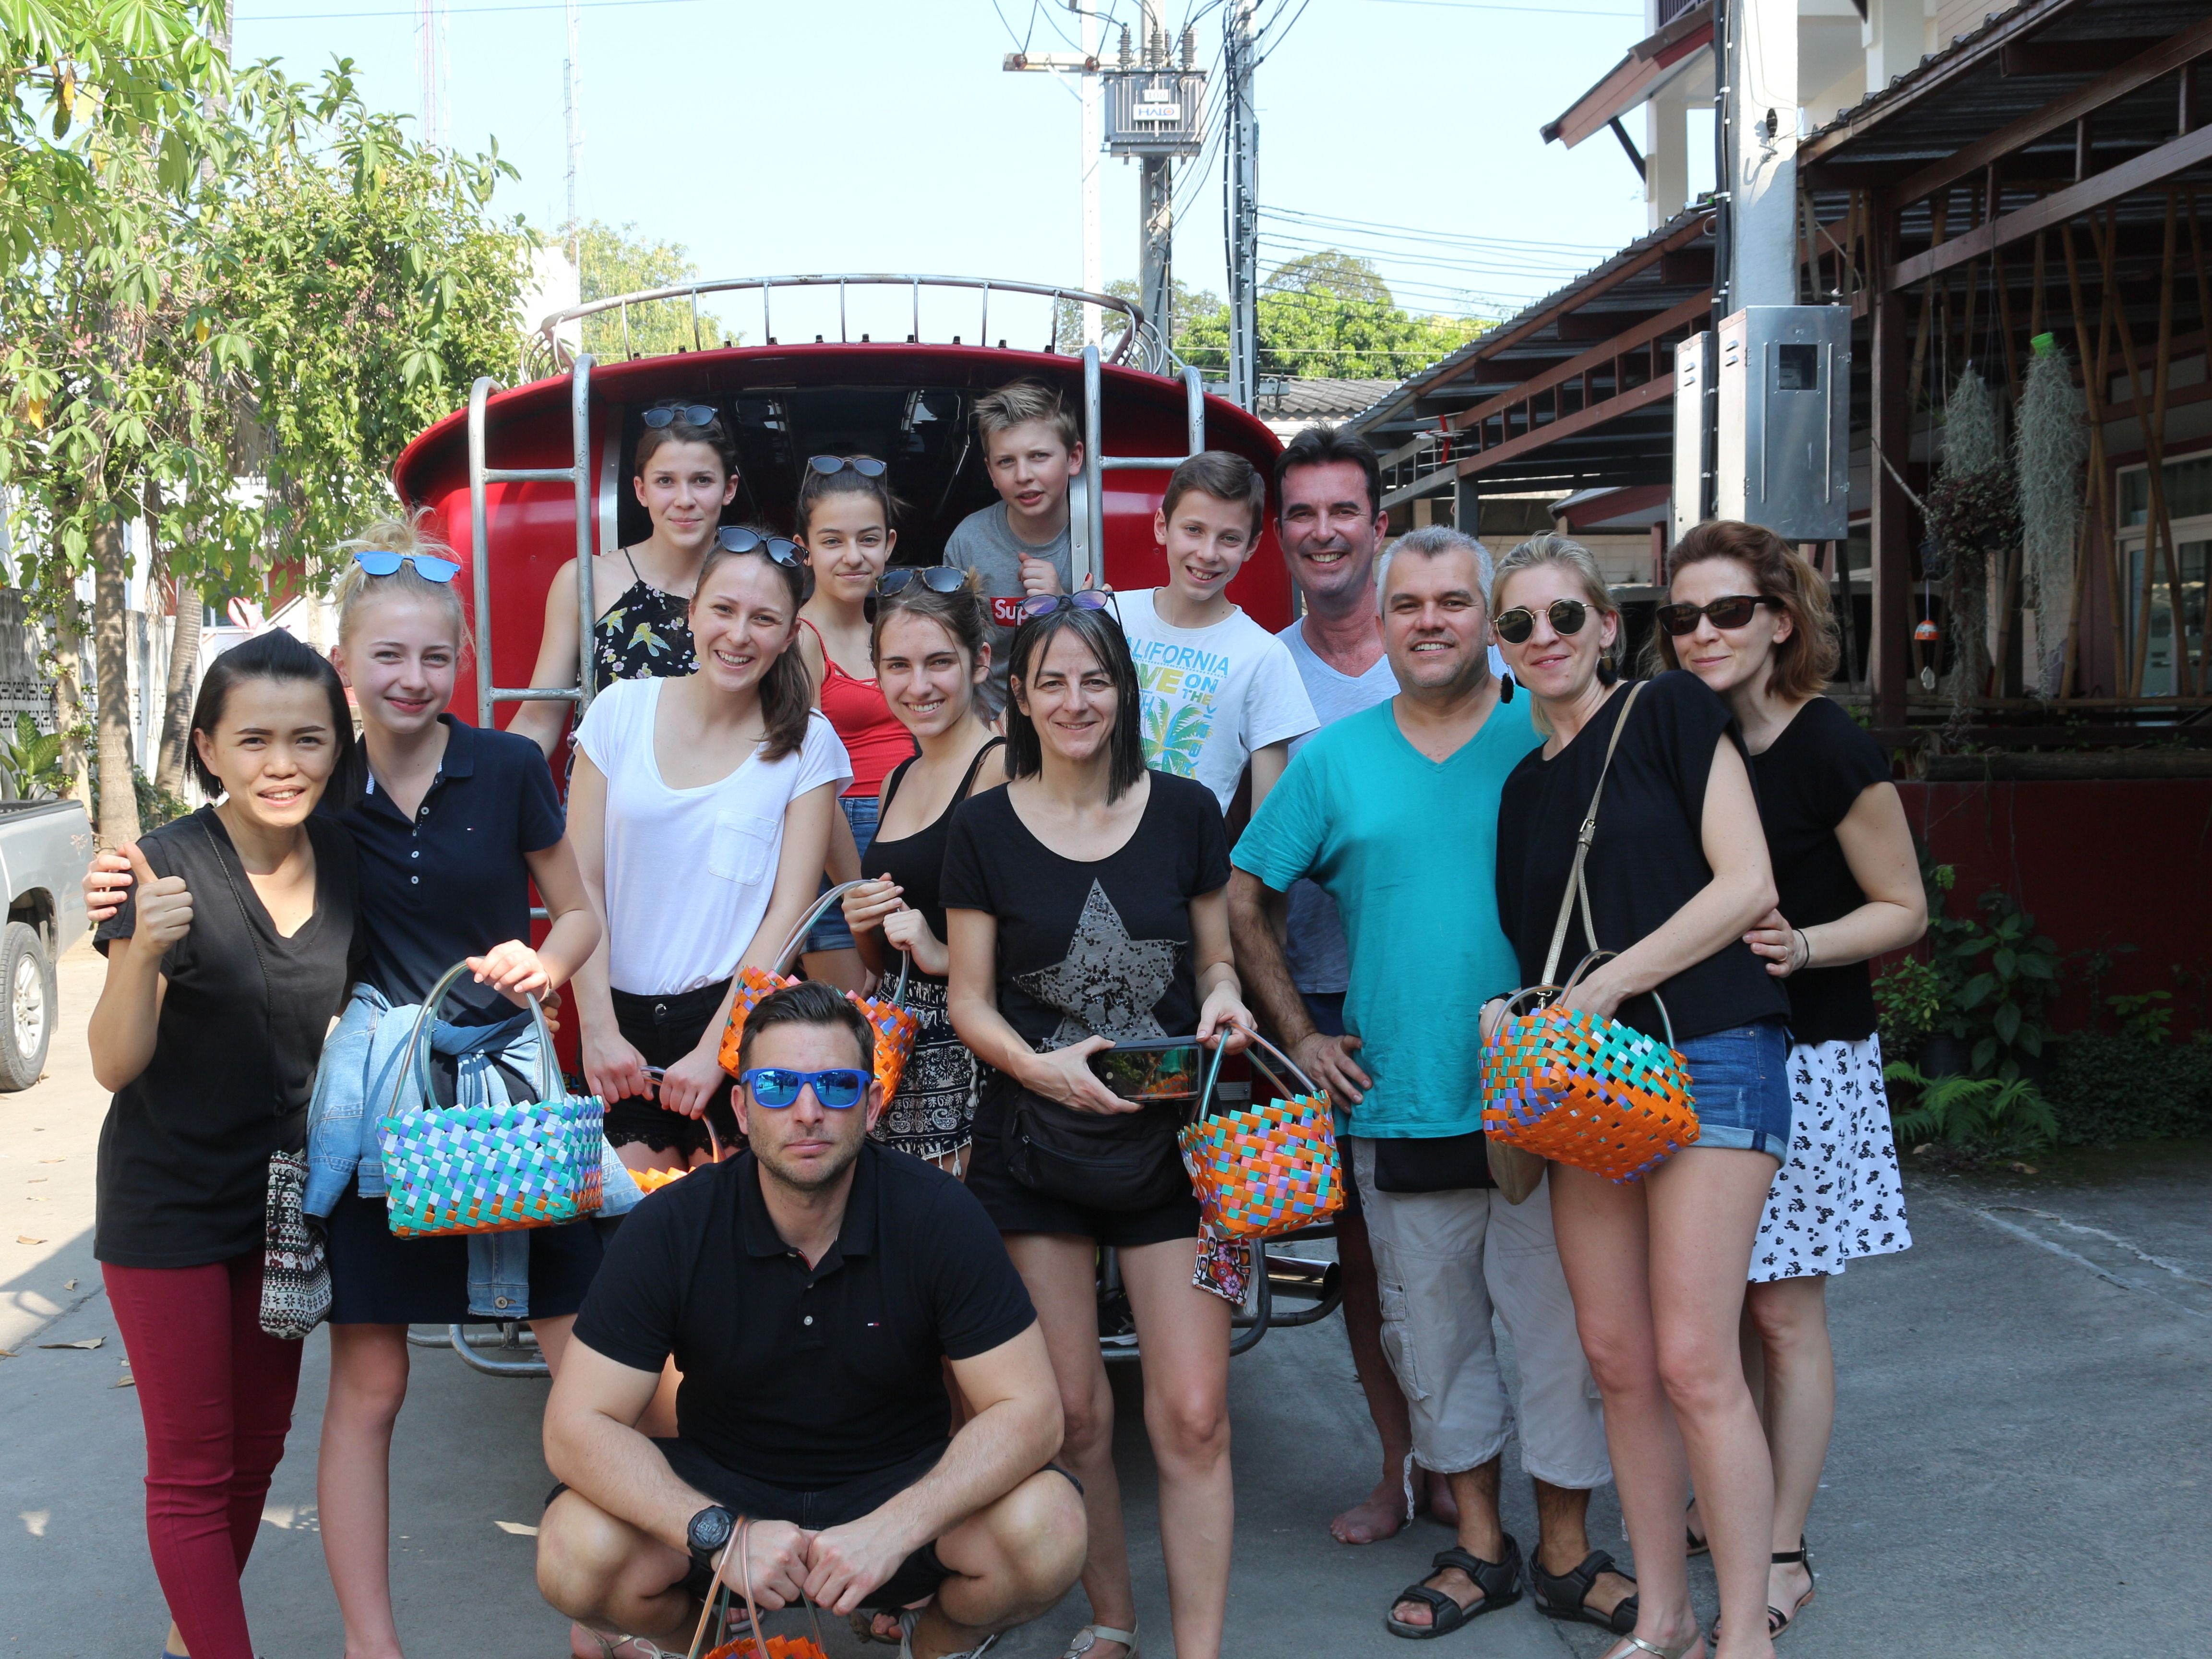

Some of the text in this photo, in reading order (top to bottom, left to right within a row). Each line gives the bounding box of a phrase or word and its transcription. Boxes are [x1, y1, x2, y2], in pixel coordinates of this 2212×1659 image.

[1139, 108, 1174, 116] HALO
[995, 599, 1029, 626] Sup
[1184, 673, 1220, 694] ON
[1182, 688, 1214, 706] THE
